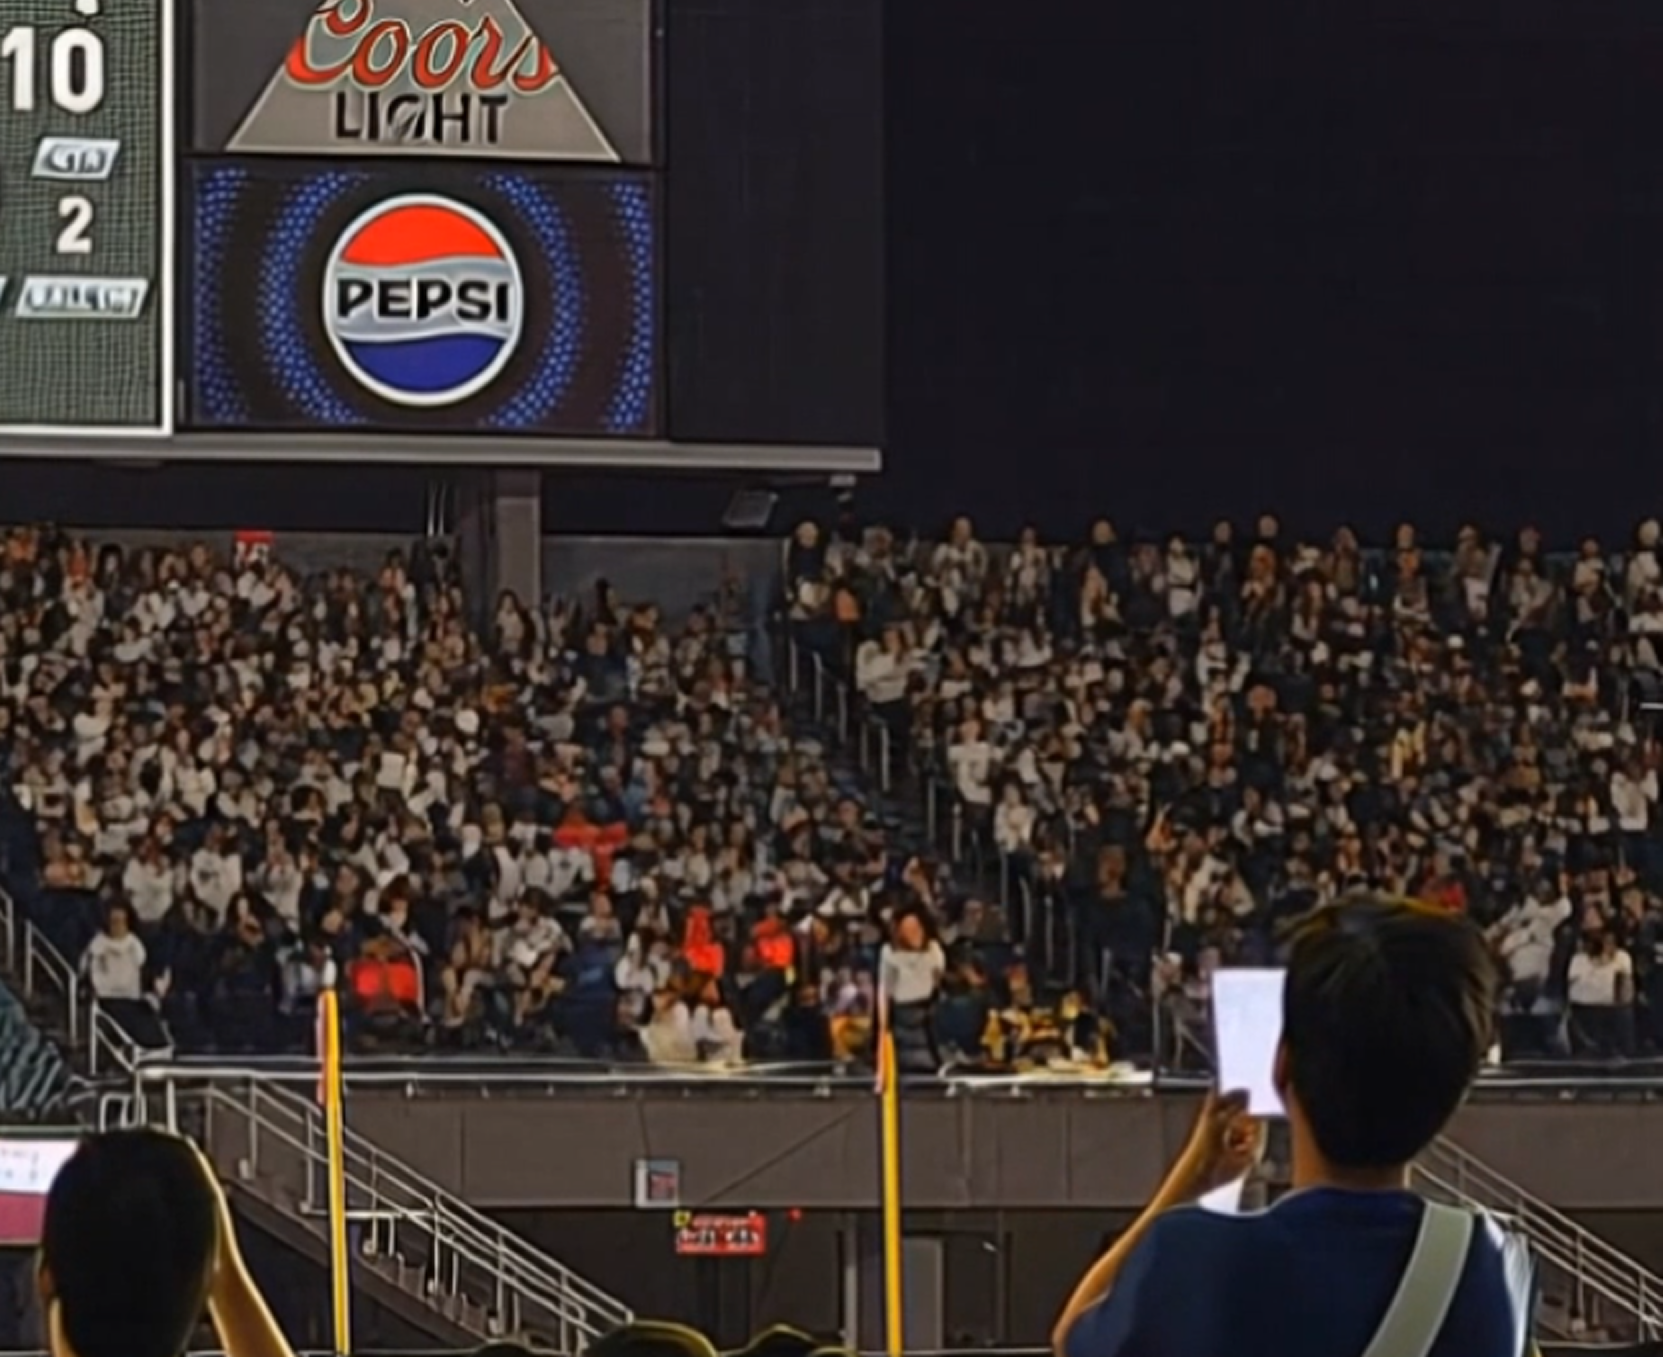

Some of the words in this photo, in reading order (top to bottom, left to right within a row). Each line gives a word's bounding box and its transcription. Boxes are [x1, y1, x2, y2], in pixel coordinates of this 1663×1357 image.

[1, 26, 104, 114] 10
[333, 93, 507, 147] LIGHT
[56, 195, 94, 254] 2
[337, 276, 511, 324] PEPSI
